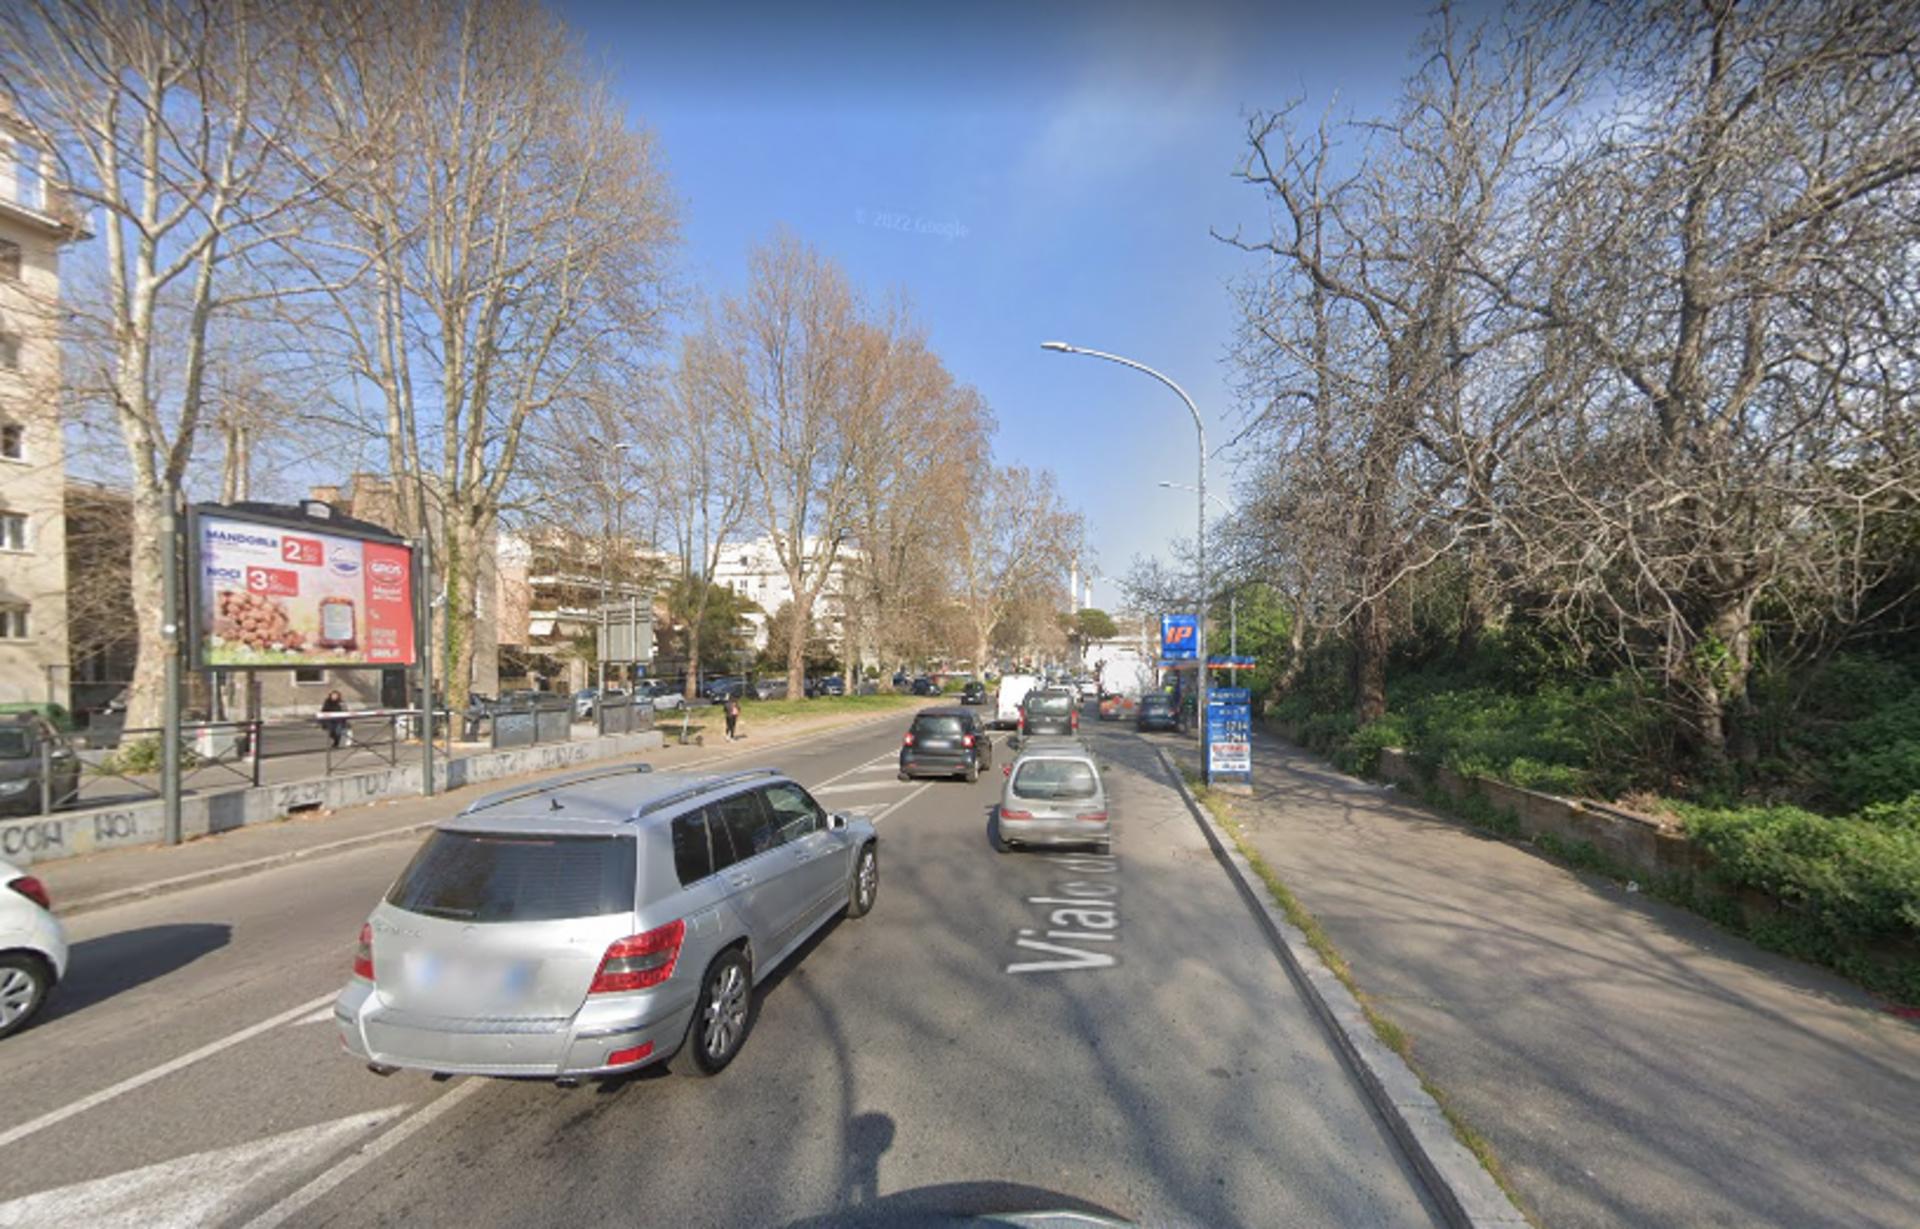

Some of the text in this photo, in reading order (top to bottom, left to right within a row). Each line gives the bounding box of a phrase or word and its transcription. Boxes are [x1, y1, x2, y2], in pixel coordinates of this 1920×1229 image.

[284, 540, 302, 561] 2
[205, 566, 241, 579] NOCI
[250, 569, 268, 590] 3
[1167, 627, 1193, 643] IP
